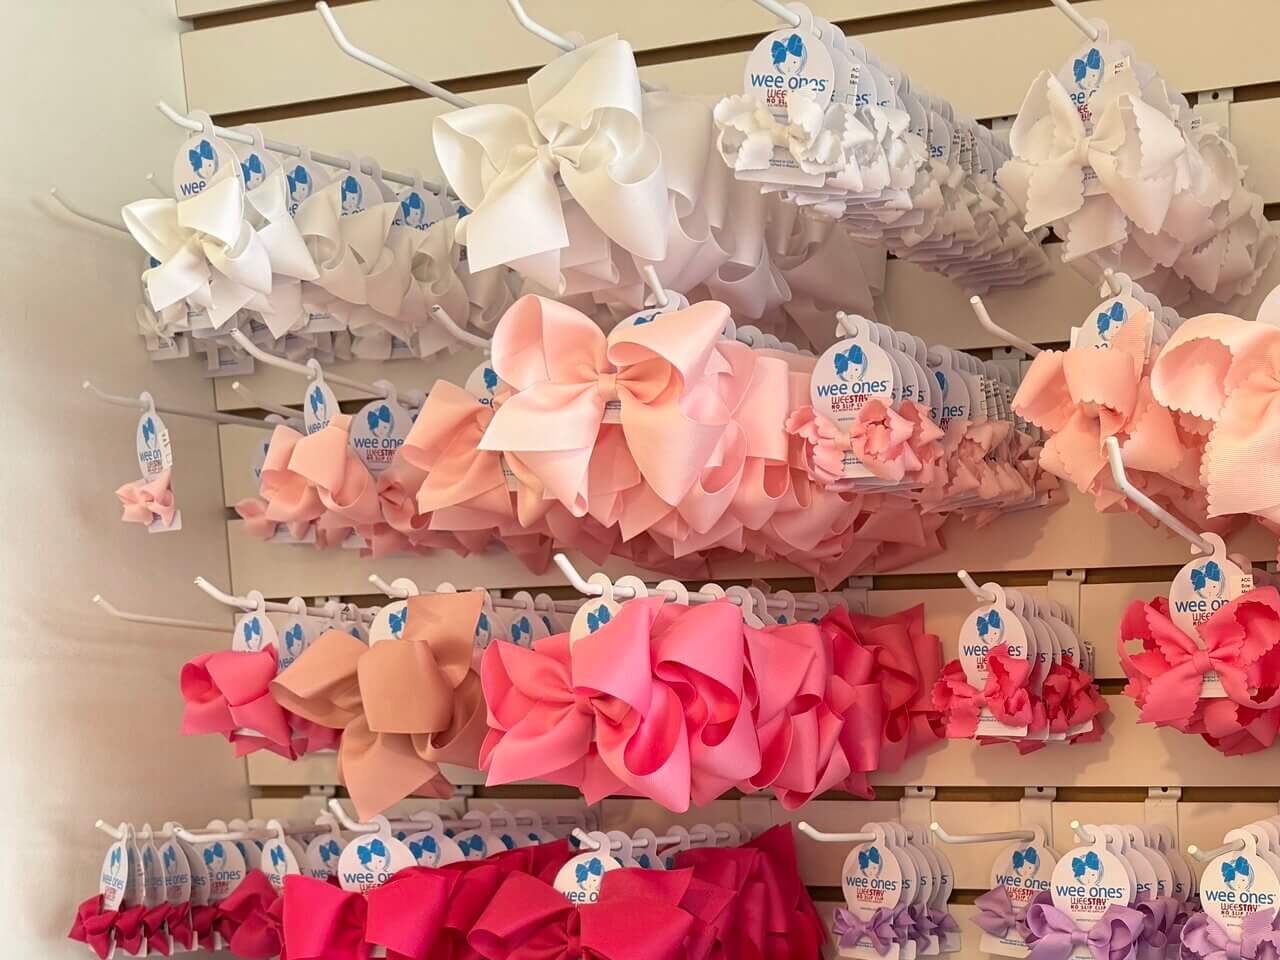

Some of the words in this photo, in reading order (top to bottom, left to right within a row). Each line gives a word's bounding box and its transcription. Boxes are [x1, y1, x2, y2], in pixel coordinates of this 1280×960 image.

[751, 74, 784, 88] wee
[180, 181, 206, 197] wee
[817, 385, 848, 397] wee
[852, 380, 887, 393] ones
[354, 437, 378, 448] wee
[1175, 599, 1206, 612] wee
[216, 870, 241, 881] ones
[344, 872, 373, 883] wee
[996, 874, 1020, 886] wee
[847, 876, 868, 888] wee
[872, 878, 897, 890] ones
[1056, 886, 1085, 897] wee
[1089, 887, 1123, 899] ones
[1205, 890, 1235, 903] wee
[1240, 891, 1273, 905] ones
